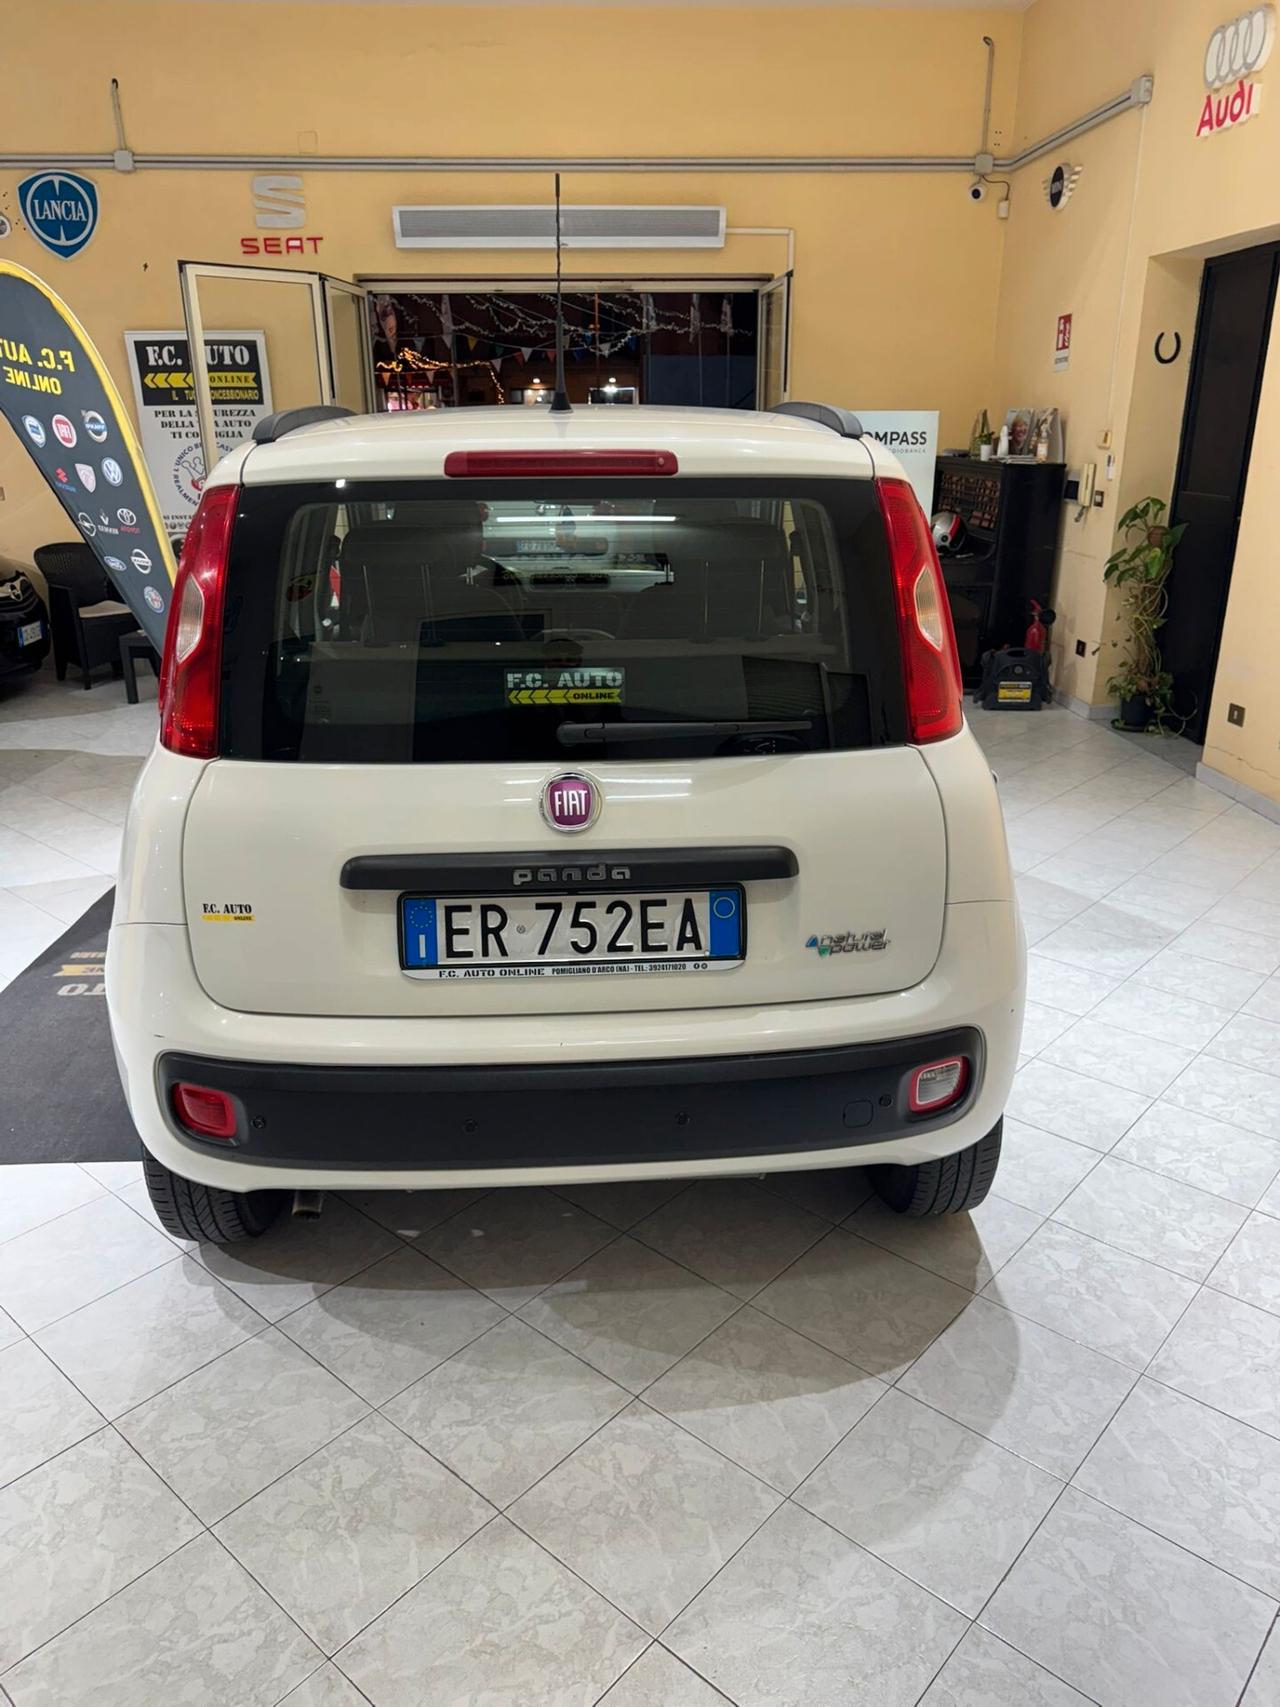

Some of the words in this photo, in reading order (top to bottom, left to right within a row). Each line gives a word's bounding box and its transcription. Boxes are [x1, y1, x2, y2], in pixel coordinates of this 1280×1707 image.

[1196, 80, 1254, 137] Audi
[33, 199, 88, 221] LANCIA
[240, 236, 324, 255] SEAT
[145, 345, 183, 366] F.C.
[203, 345, 250, 366] UTO
[209, 375, 250, 384] ONLINE
[210, 389, 259, 401] ONCESSIONARIO
[154, 409, 176, 418] PER
[179, 409, 193, 418] LA
[161, 420, 195, 429] DELLA
[222, 420, 252, 428] AUTO
[170, 431, 183, 439] TI
[185, 430, 244, 439] COIGLIA
[863, 431, 928, 446] MPASS
[506, 672, 549, 689] F.C.
[557, 672, 623, 688] AUTO
[573, 692, 614, 700] ONLINE
[554, 790, 588, 817] FIAT
[512, 864, 631, 886] panda
[202, 903, 220, 914] F.C.
[223, 903, 252, 914] AUTO
[445, 904, 509, 958] ER
[535, 898, 703, 955] 752EA
[438, 970, 460, 978] F.C.
[463, 969, 496, 977] AUTO
[499, 968, 545, 977] ONLINE
[551, 966, 591, 975] POMIGLIANO
